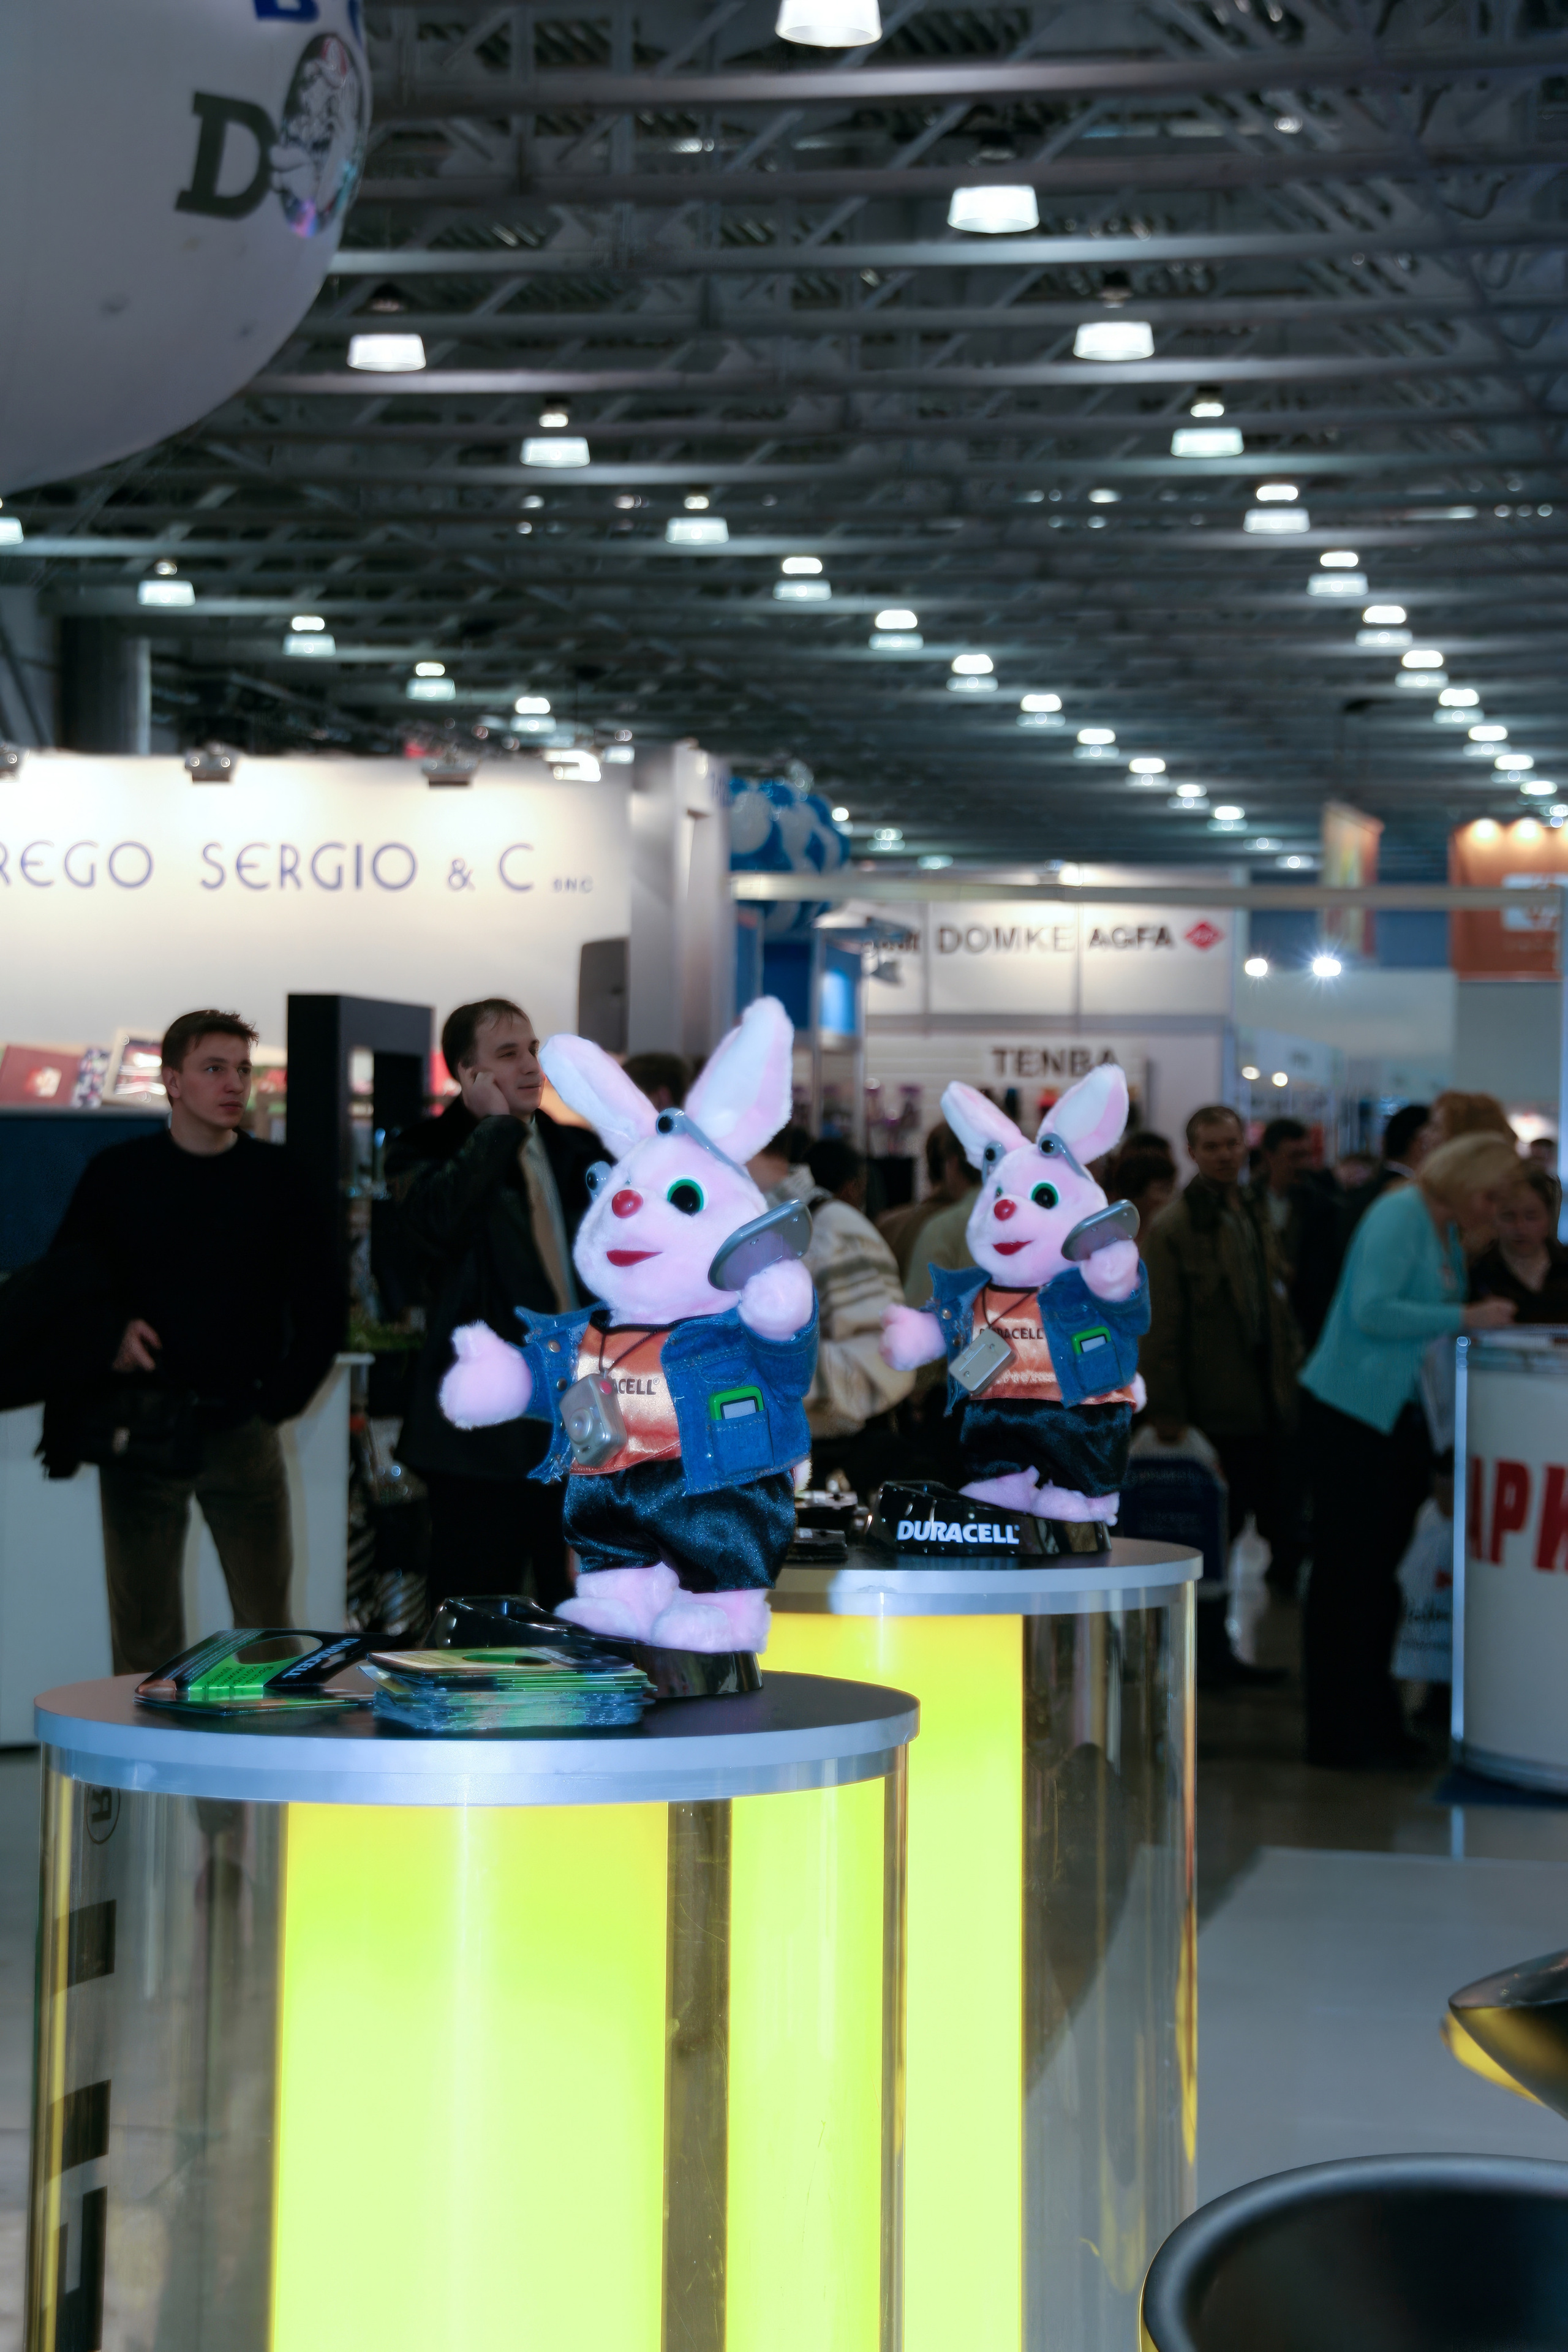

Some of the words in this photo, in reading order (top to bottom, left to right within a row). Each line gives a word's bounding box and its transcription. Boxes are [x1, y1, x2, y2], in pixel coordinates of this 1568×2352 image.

[200, 841, 418, 891] SERGIO
[448, 858, 475, 891] &
[498, 842, 535, 892] C
[938, 926, 1077, 954] DOMKE
[1088, 927, 1174, 950] AGFA
[897, 1520, 1020, 1545] DURACELL
